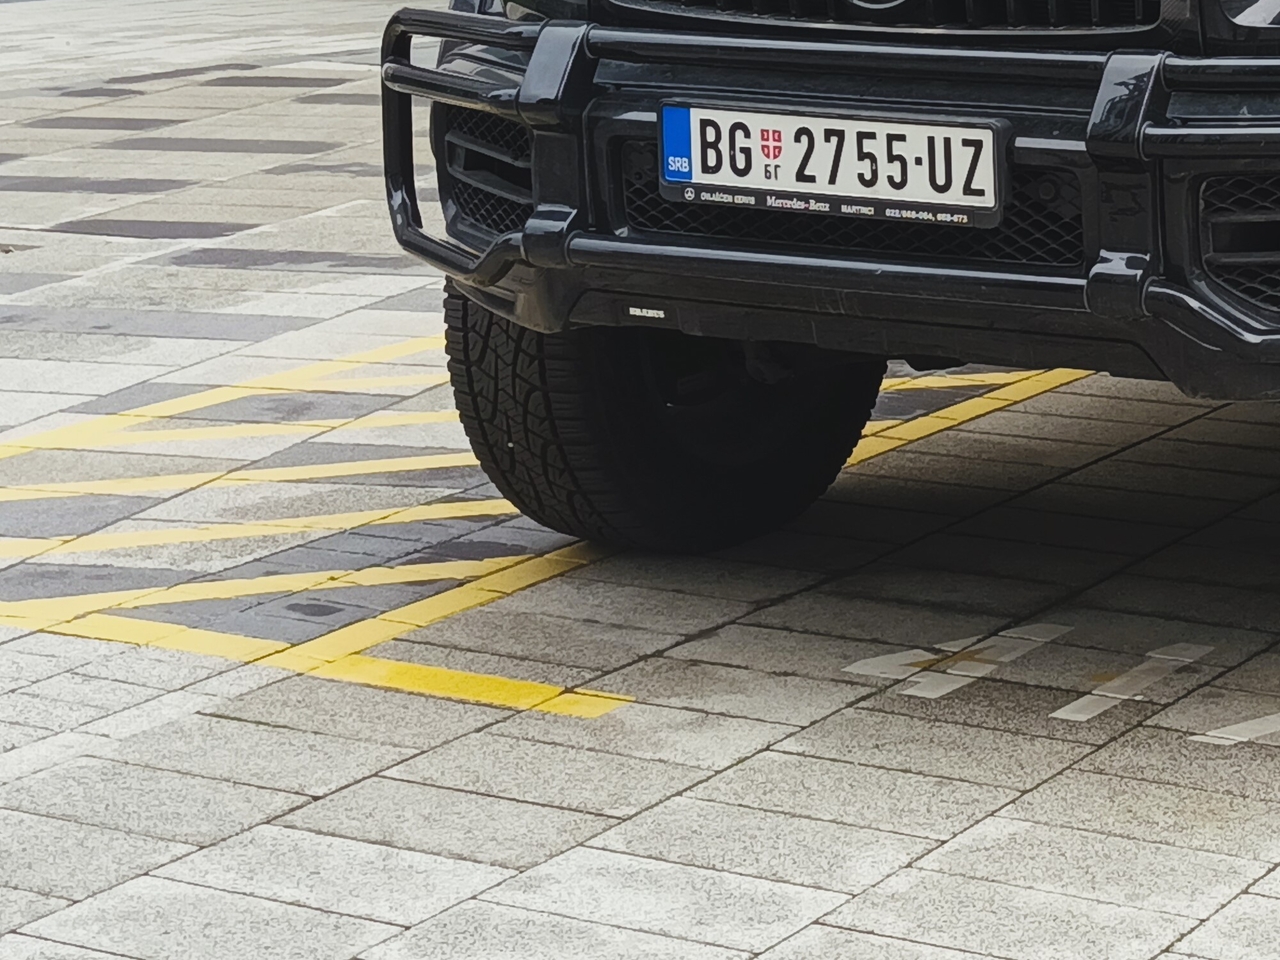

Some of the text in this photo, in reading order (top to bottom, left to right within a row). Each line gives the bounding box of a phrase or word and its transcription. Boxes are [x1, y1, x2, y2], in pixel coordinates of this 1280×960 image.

[699, 117, 752, 178] BG
[668, 156, 689, 172] SRB
[766, 196, 830, 212] Mercedes-Benz
